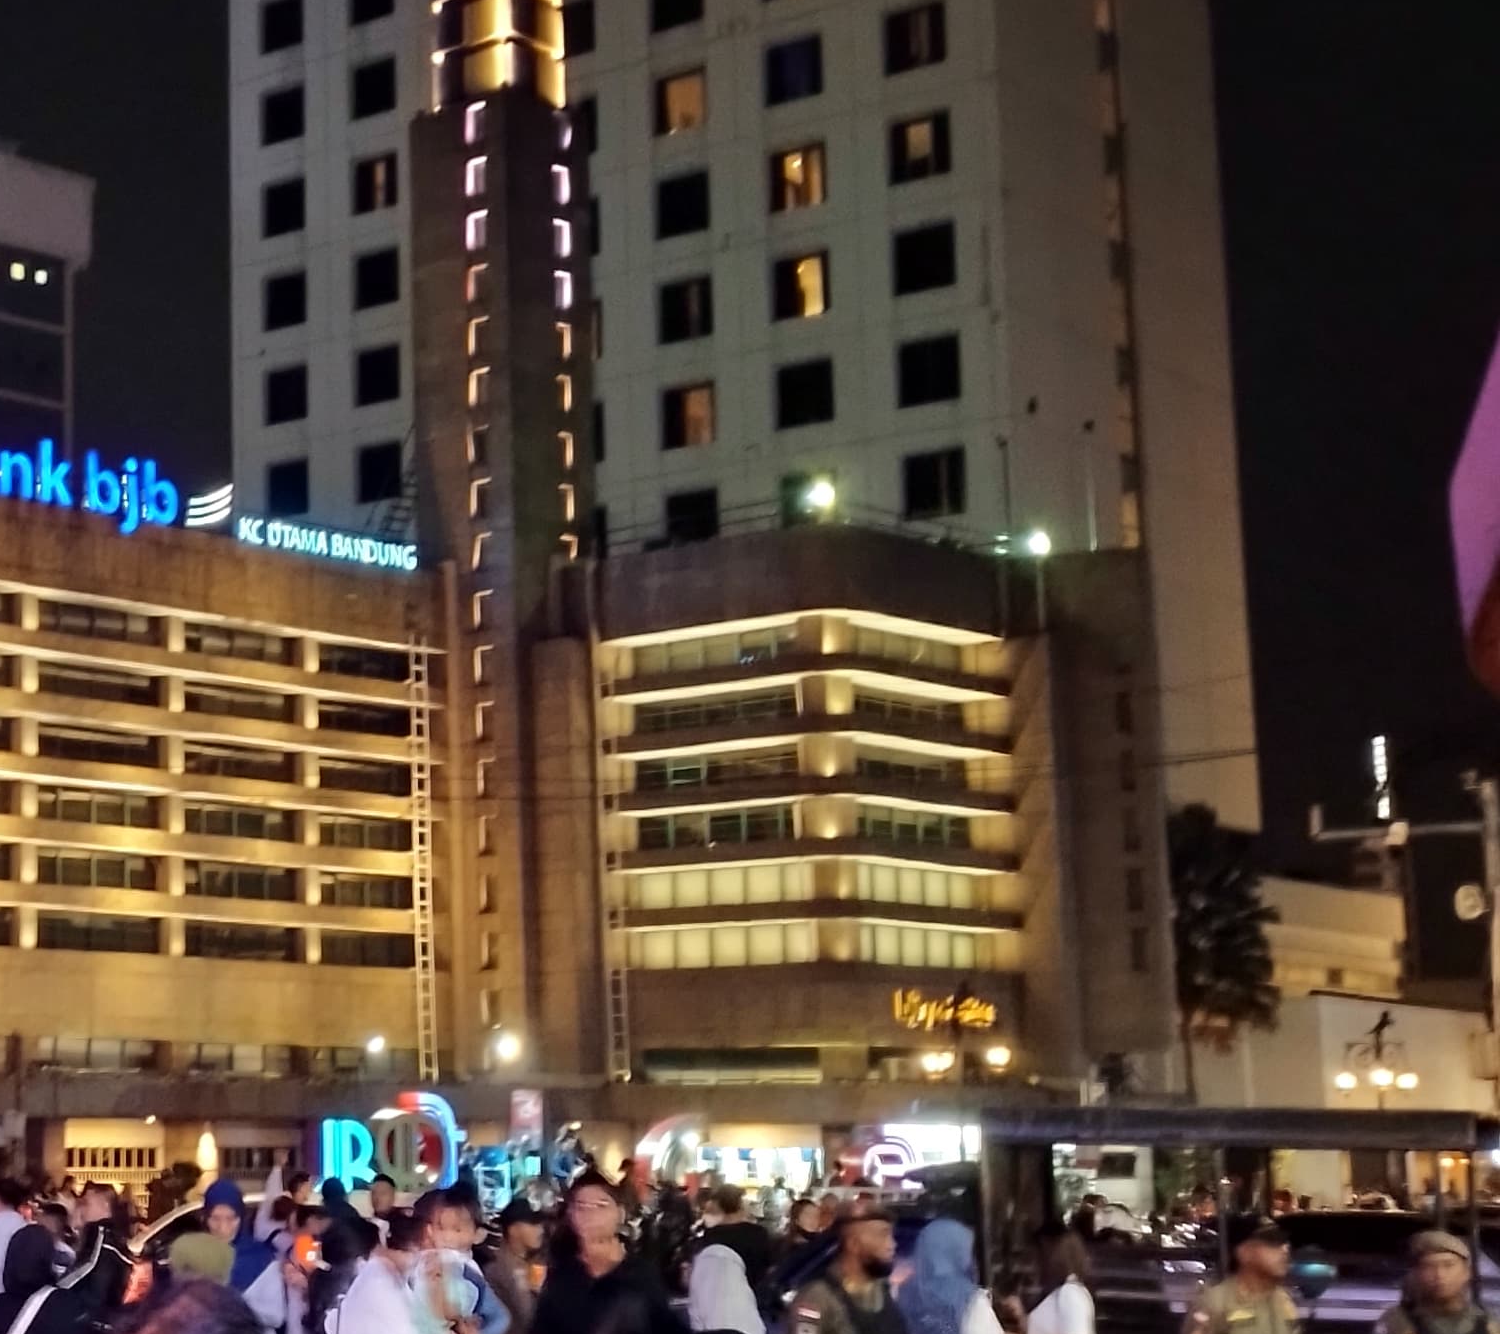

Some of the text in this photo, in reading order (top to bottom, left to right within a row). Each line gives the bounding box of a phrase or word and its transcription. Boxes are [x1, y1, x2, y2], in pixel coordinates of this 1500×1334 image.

[83, 448, 180, 533] bjb
[238, 516, 418, 571] KC UTAMA BANDUNG
